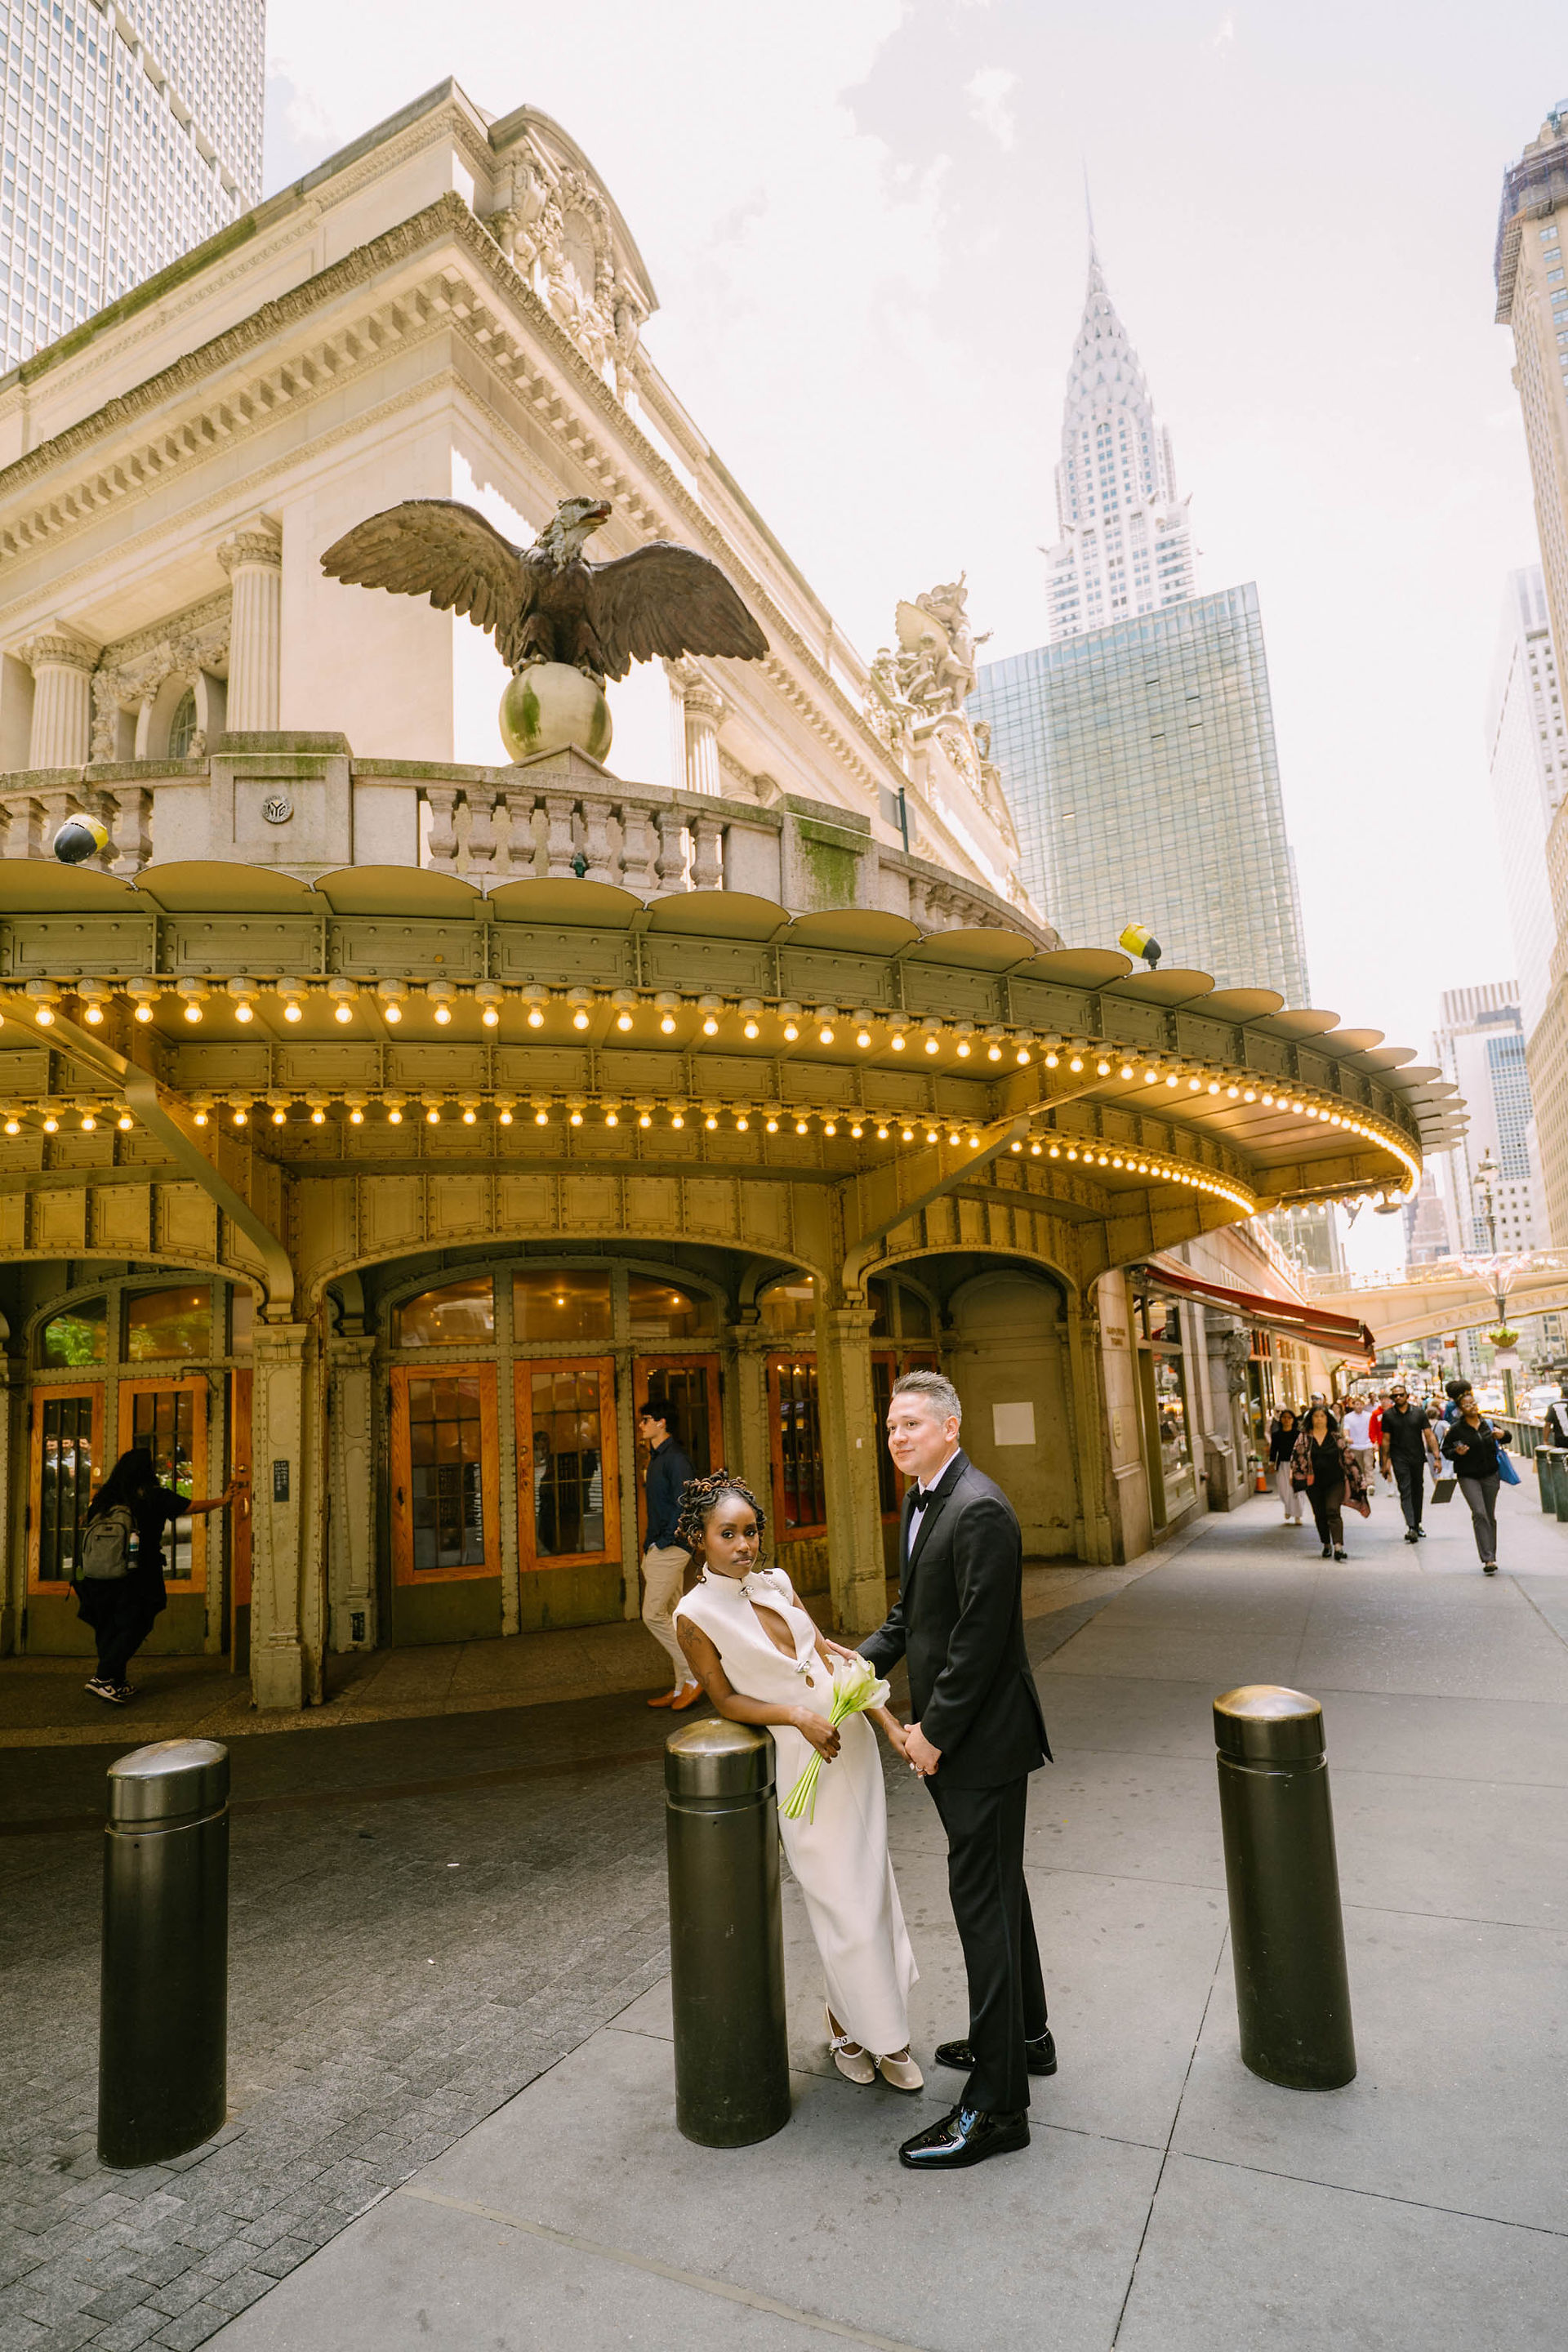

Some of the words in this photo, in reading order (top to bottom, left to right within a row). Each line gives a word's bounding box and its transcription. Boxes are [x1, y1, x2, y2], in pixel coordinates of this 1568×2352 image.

[267, 802, 286, 817] NYC
[1432, 1305, 1491, 1327] GRAND
[1510, 1290, 1568, 1310] ENTR
